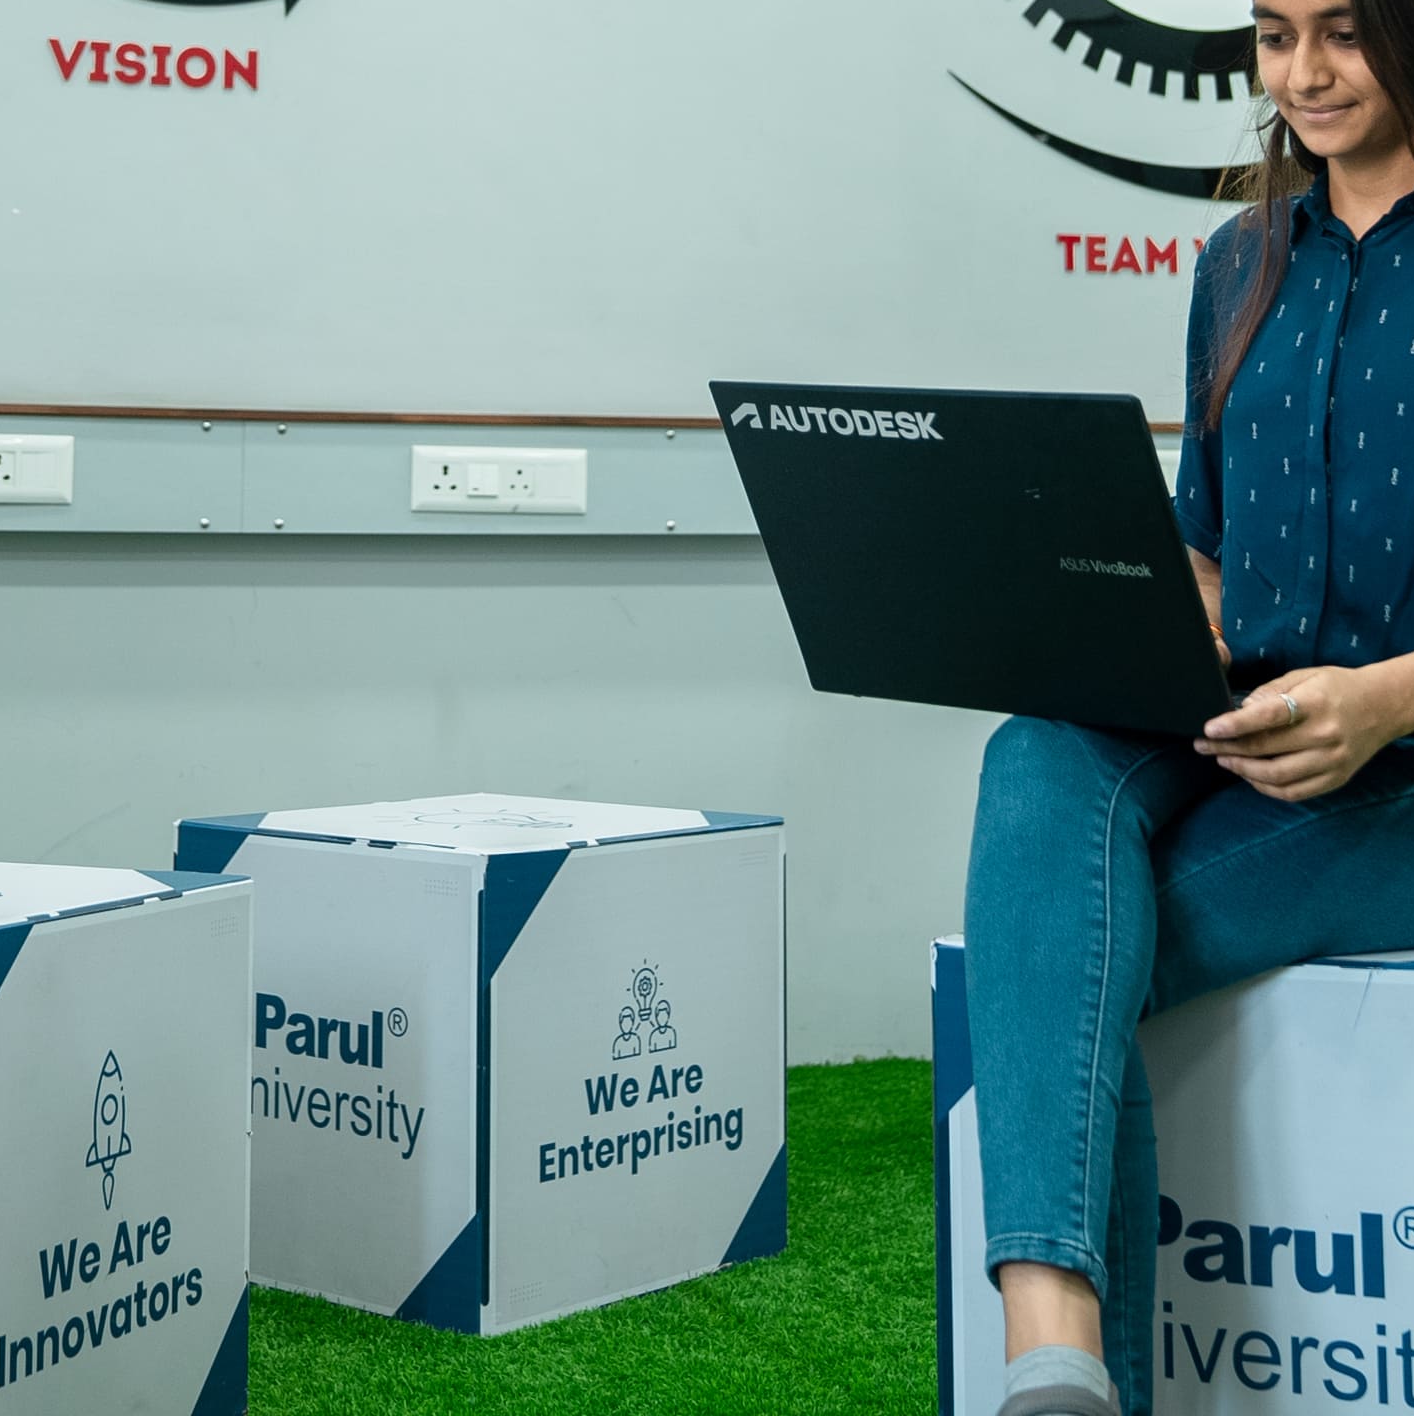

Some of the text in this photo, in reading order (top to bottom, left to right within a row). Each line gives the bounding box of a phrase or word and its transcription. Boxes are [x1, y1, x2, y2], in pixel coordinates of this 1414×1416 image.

[49, 38, 259, 89] VISION
[1057, 233, 1179, 274] TEAM
[770, 404, 944, 440] AUTODESK
[1060, 558, 1153, 578] ASUS VivoBook
[251, 1066, 425, 1160] niversity
[584, 1064, 703, 1116] We Are
[539, 1103, 743, 1183] Enterprising
[39, 1215, 172, 1300] We Are
